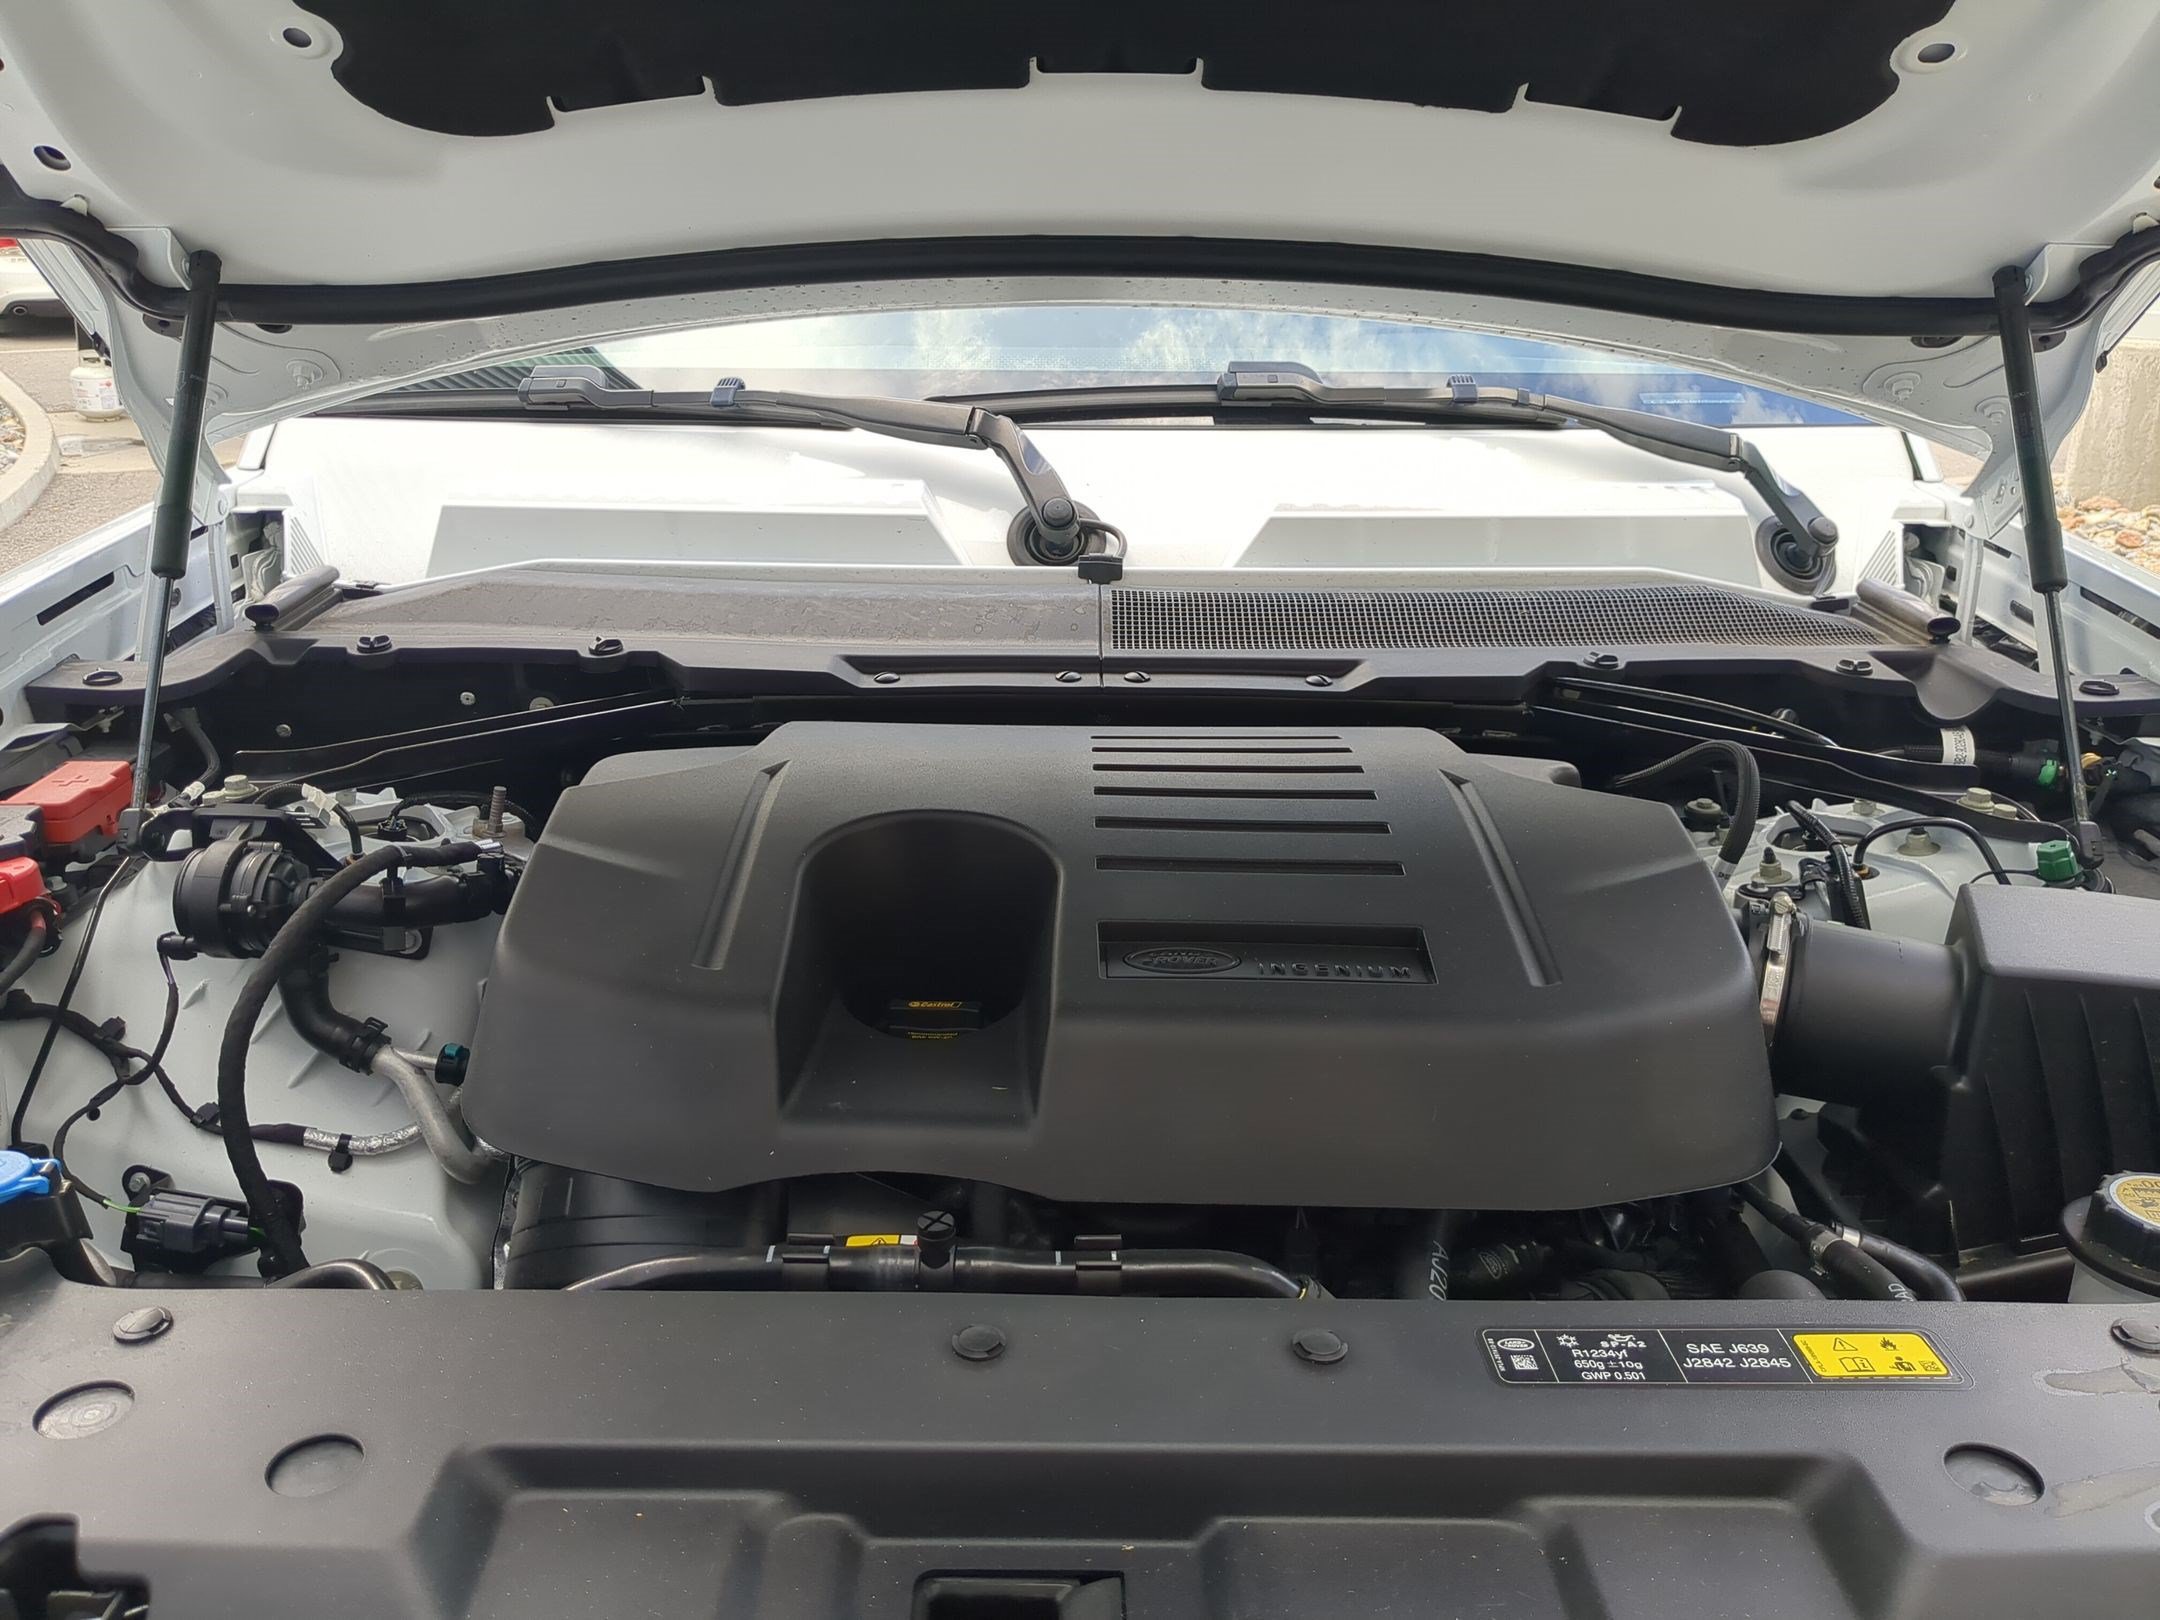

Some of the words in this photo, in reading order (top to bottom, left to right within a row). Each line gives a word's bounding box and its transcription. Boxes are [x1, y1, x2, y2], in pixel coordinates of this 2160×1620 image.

[1258, 962, 1410, 979] INGENIUM
[920, 1001, 963, 1009] Castrol
[1686, 1343, 1725, 1354] SAE
[1729, 1343, 1769, 1354] J639
[1572, 1349, 1628, 1360] R1234yf
[1574, 1360, 1605, 1370] 650g
[1683, 1357, 1736, 1368] J2842
[1739, 1357, 1792, 1368] J2845
[1581, 1371, 1611, 1380] GWP
[1614, 1371, 1646, 1380] 0.501
